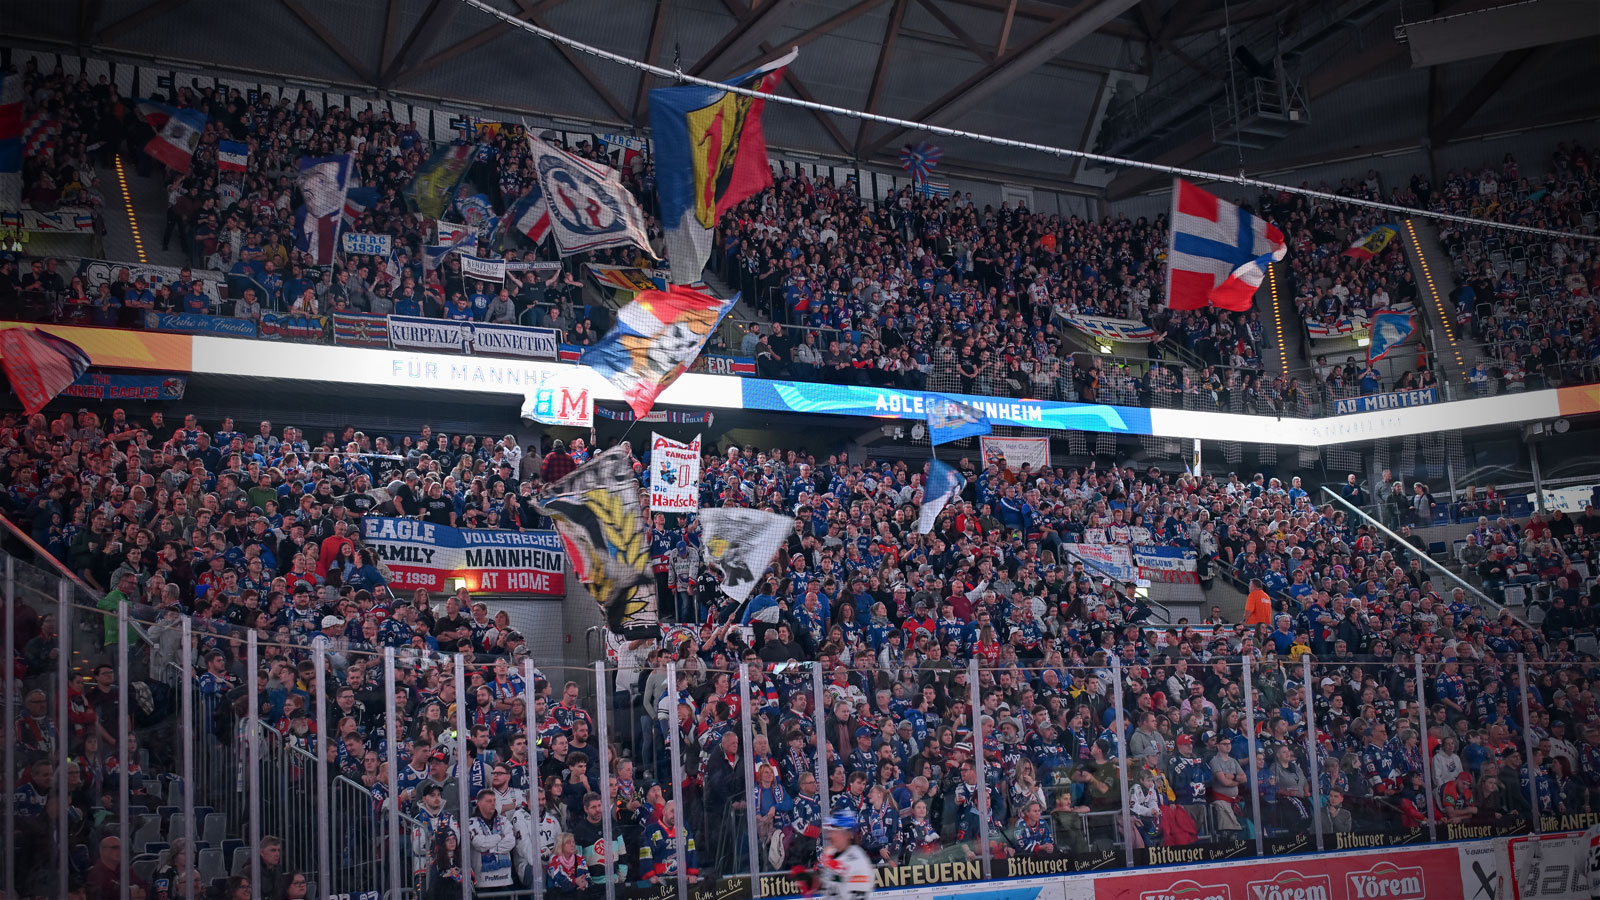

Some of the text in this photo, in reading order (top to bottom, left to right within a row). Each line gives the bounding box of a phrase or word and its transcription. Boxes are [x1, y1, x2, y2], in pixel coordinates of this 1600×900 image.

[604, 134, 632, 147] MERC
[348, 234, 386, 244] MERC
[163, 314, 254, 334] Ruhe in Frieden
[391, 325, 555, 352] KURPFALZ CONNECTION
[392, 356, 438, 380] FÜR
[93, 375, 111, 385] THE
[65, 385, 159, 398] NKEN EAGLES
[1337, 390, 1432, 414] AD MORTEM
[666, 451, 697, 460] FANCLUB
[652, 493, 697, 507] Härdsche
[365, 518, 436, 543] EAGLE
[462, 532, 561, 548] VOLLSTRECKER
[465, 548, 561, 572] MANNHEIM
[406, 572, 436, 585] 1998
[481, 572, 550, 591] AT HOME
[1447, 823, 1492, 841] Bitburger
[1541, 815, 1559, 832] Bitte
[1296, 834, 1307, 844] Bit
[1336, 831, 1385, 849] Bitburger
[1148, 845, 1204, 865] Bitburger
[1210, 849, 1224, 861] Bitte
[1234, 840, 1247, 850] Bit
[1007, 856, 1068, 877] Bitburger
[1074, 861, 1090, 872] Bitte
[1102, 850, 1115, 860] Bit
[873, 860, 981, 888] ANFEUERN
[660, 885, 676, 896] Bit
[727, 879, 744, 890] Bit
[759, 876, 801, 897] Bitbu
[1251, 884, 1328, 900] Yörem
[1350, 875, 1421, 899] Yörem
